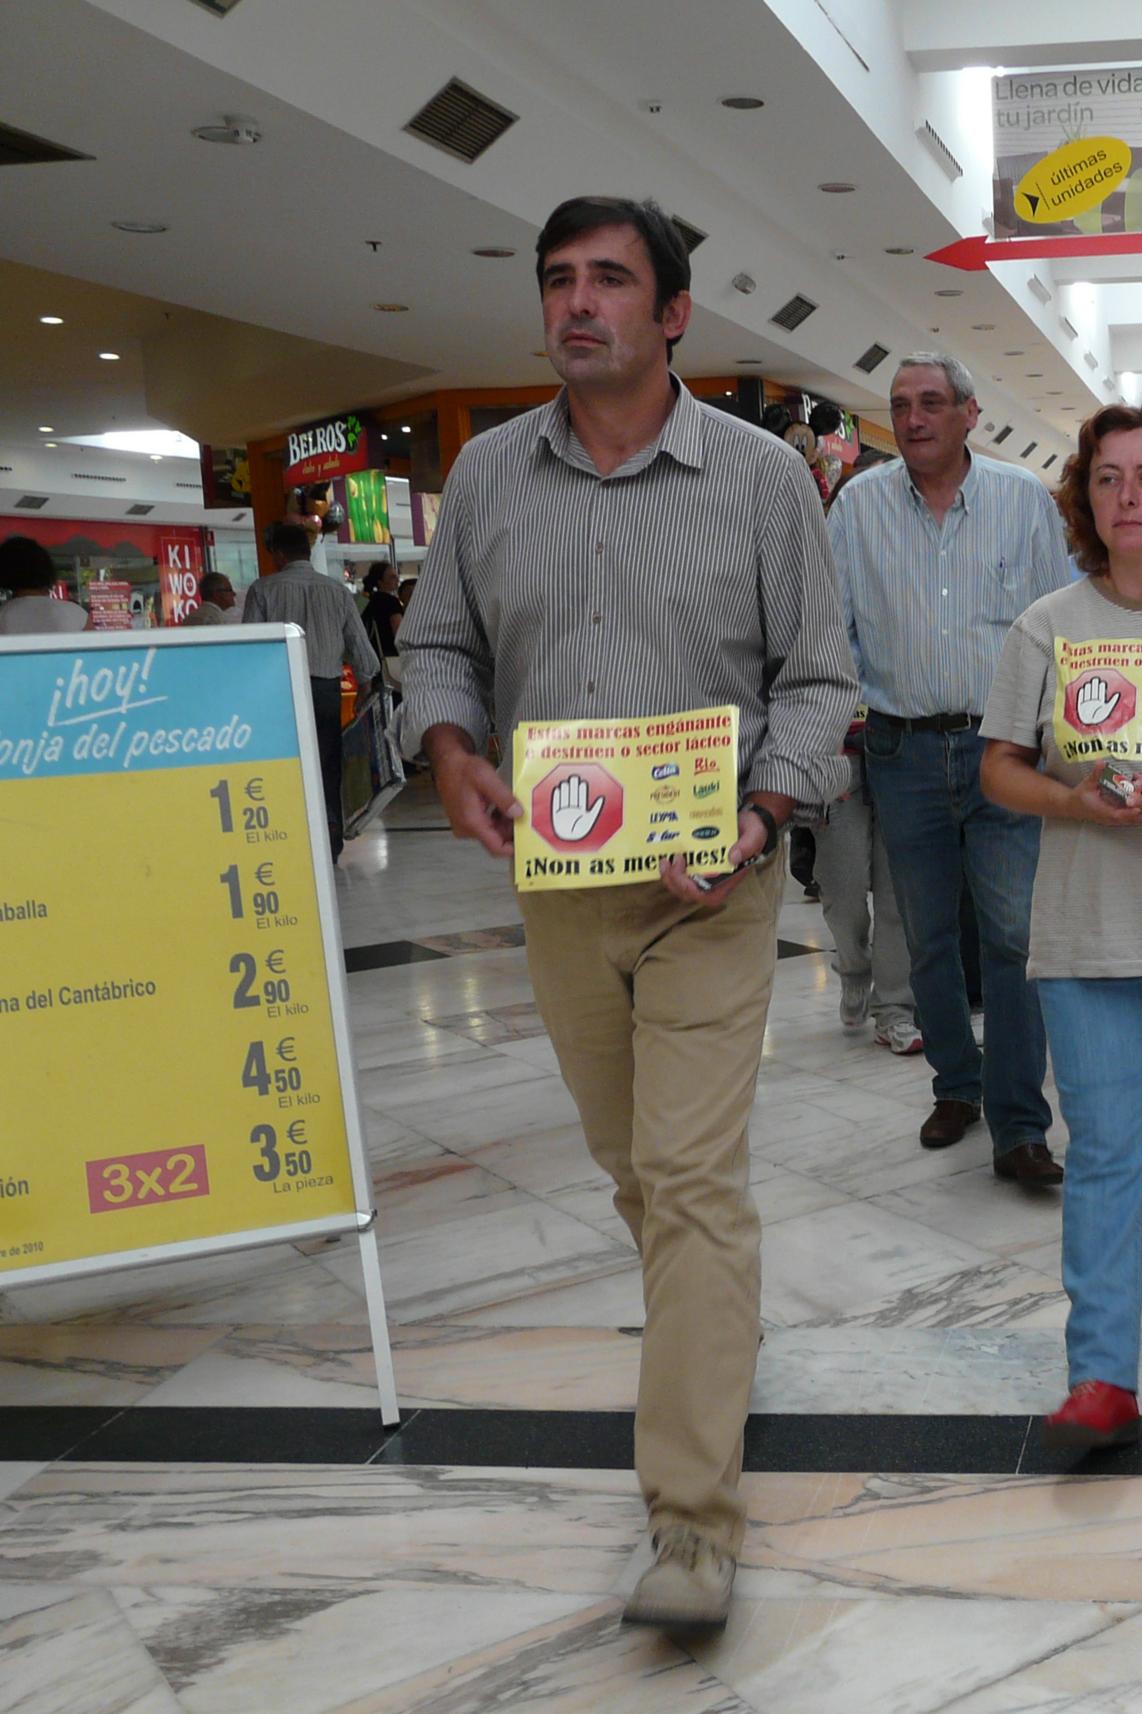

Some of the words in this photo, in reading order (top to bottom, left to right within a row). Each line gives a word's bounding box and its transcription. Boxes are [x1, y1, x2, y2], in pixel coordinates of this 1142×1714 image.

[995, 76, 1060, 101] Llena
[1063, 74, 1093, 97] de
[996, 108, 1020, 128] tu
[1022, 101, 1094, 132] jardín
[1050, 148, 1107, 186] últimas
[1050, 160, 1123, 207] unidades
[288, 421, 346, 467] BELROS
[168, 544, 190, 569] KI
[1134, 657, 1142, 668] o
[48, 647, 157, 727] ¡hoy!
[72, 720, 127, 760] del
[126, 714, 251, 768] pescado
[527, 723, 571, 741] Estas
[577, 721, 640, 740] marcas
[646, 714, 732, 737] engánante
[621, 743, 631, 758] o
[636, 739, 681, 758] sector
[686, 734, 732, 752] lácteo
[1064, 736, 1104, 760] ¡Non
[1107, 739, 1128, 754] as
[210, 779, 234, 833] 1
[243, 806, 269, 830] 20
[246, 832, 260, 844] El
[264, 829, 288, 842] kilo
[525, 856, 580, 878] ¡Non
[590, 857, 615, 874] as
[624, 845, 726, 872] merues!
[220, 864, 244, 919] 1
[253, 891, 279, 916] 90
[256, 918, 270, 929] El
[274, 915, 298, 927] kilo
[26, 988, 53, 1010] del
[59, 978, 156, 1006] Cantábrico
[229, 952, 261, 1009] 2
[263, 979, 290, 1004] 90
[267, 1006, 281, 1019] El
[285, 1003, 309, 1016] kilo
[241, 1041, 271, 1096] 4
[275, 1067, 301, 1092] 50
[278, 1096, 292, 1109] El
[296, 1092, 320, 1106] kilo
[251, 1124, 280, 1182] 3
[285, 1150, 312, 1177] 50
[102, 1153, 199, 1204] 3x2
[273, 1181, 291, 1194] La
[295, 1174, 334, 1190] pieza
[22, 1240, 44, 1255] 2010
